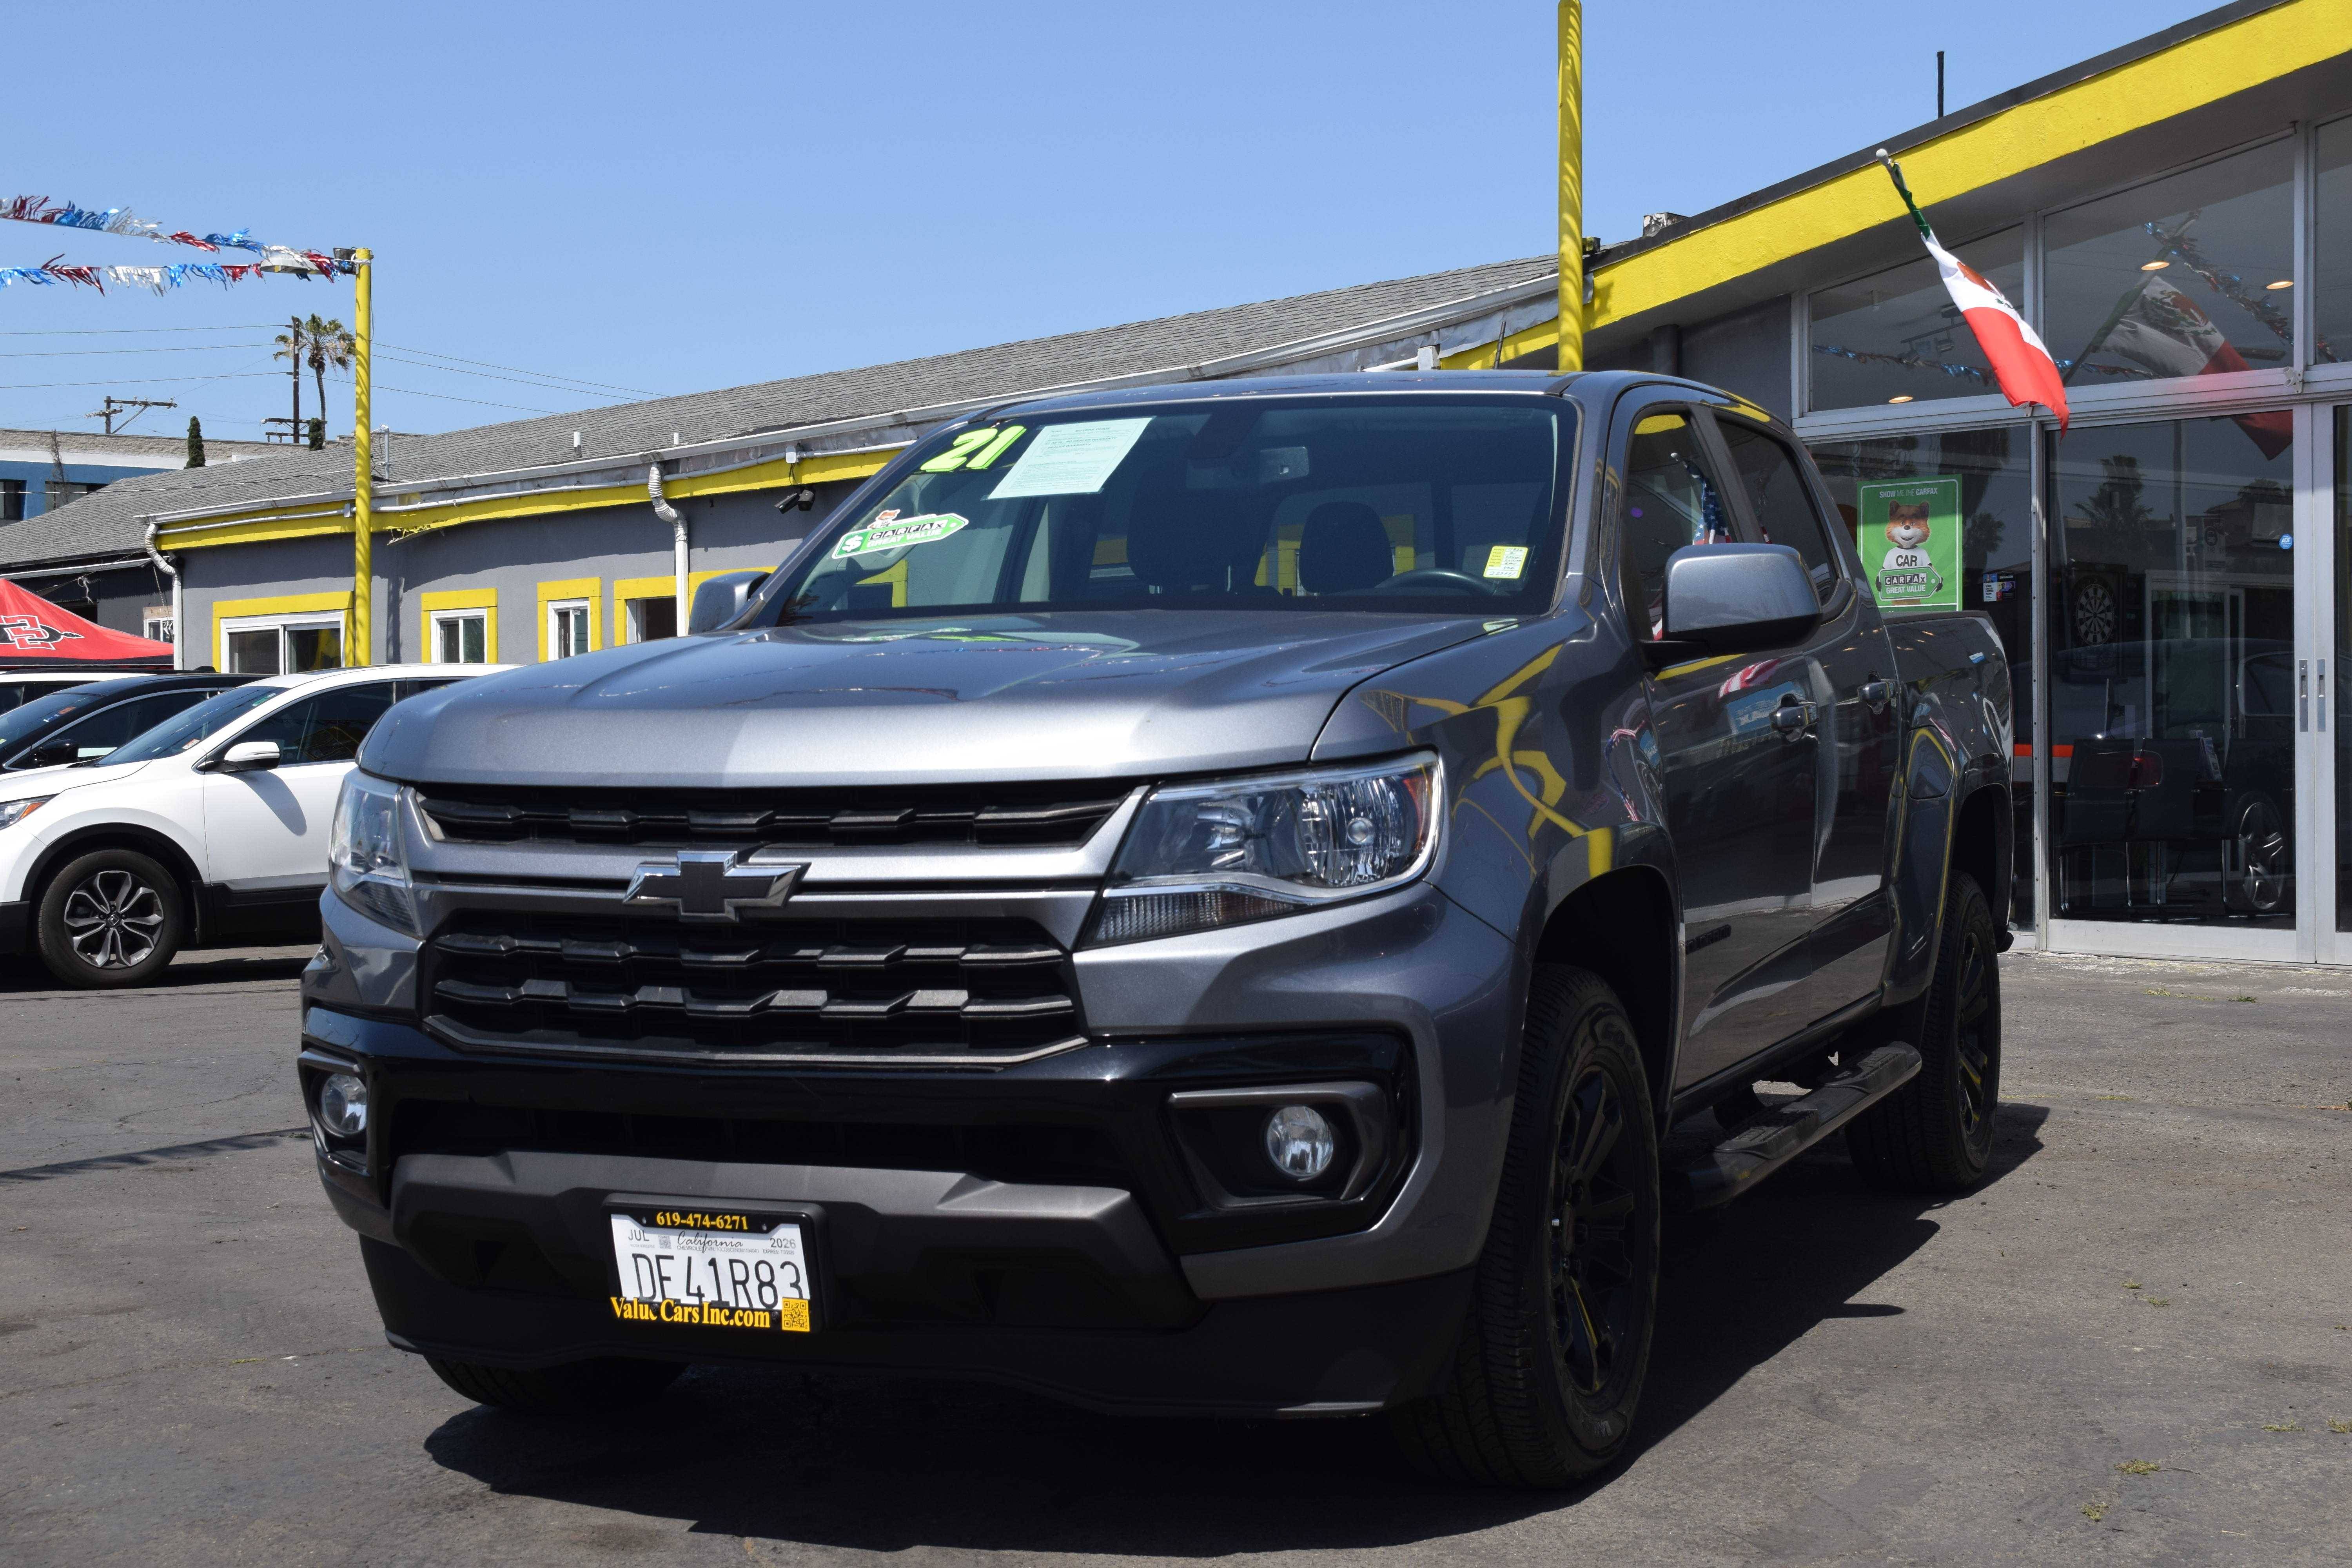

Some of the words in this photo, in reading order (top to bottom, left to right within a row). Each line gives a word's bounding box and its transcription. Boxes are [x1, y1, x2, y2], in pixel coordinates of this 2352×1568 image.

[920, 425, 1027, 472] 21
[1916, 488, 1938, 496] CARFAX
[867, 535, 904, 547] GREAT
[906, 529, 942, 540] VALUE
[870, 521, 946, 540] CARFAX
[1896, 555, 1917, 567] CAR
[1885, 573, 1926, 585] CARFAX
[1907, 585, 1926, 593] VALUE
[656, 1211, 748, 1230] 619-474-6271
[628, 1229, 650, 1242] JUL
[677, 1230, 743, 1253] California
[769, 1238, 796, 1249] 2026
[632, 1253, 803, 1309] DE41R83
